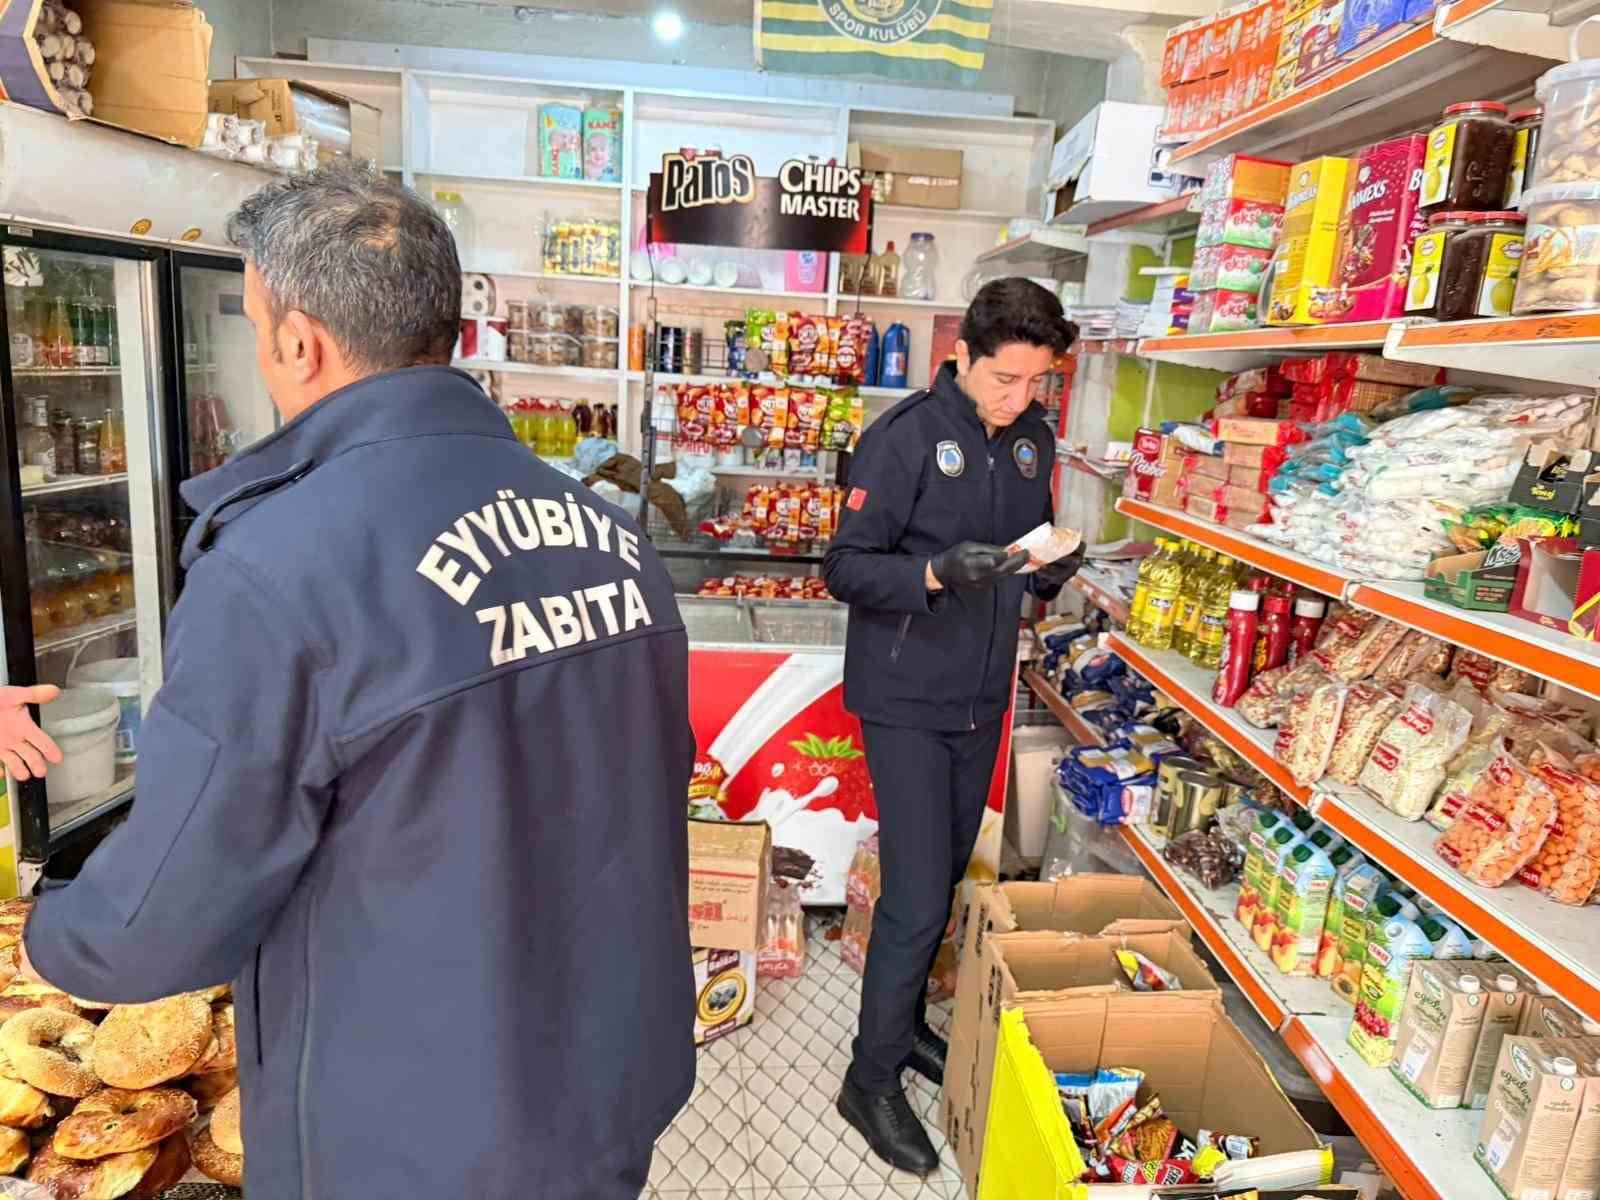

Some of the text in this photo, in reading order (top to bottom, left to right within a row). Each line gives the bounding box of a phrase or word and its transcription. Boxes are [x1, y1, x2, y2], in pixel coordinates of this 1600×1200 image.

[829, 3, 865, 36] SPOR
[779, 158, 861, 196] CHIPS
[780, 194, 861, 221] MASTER
[416, 489, 642, 606] EYYÜBİYE
[475, 578, 653, 667] ZABITA
